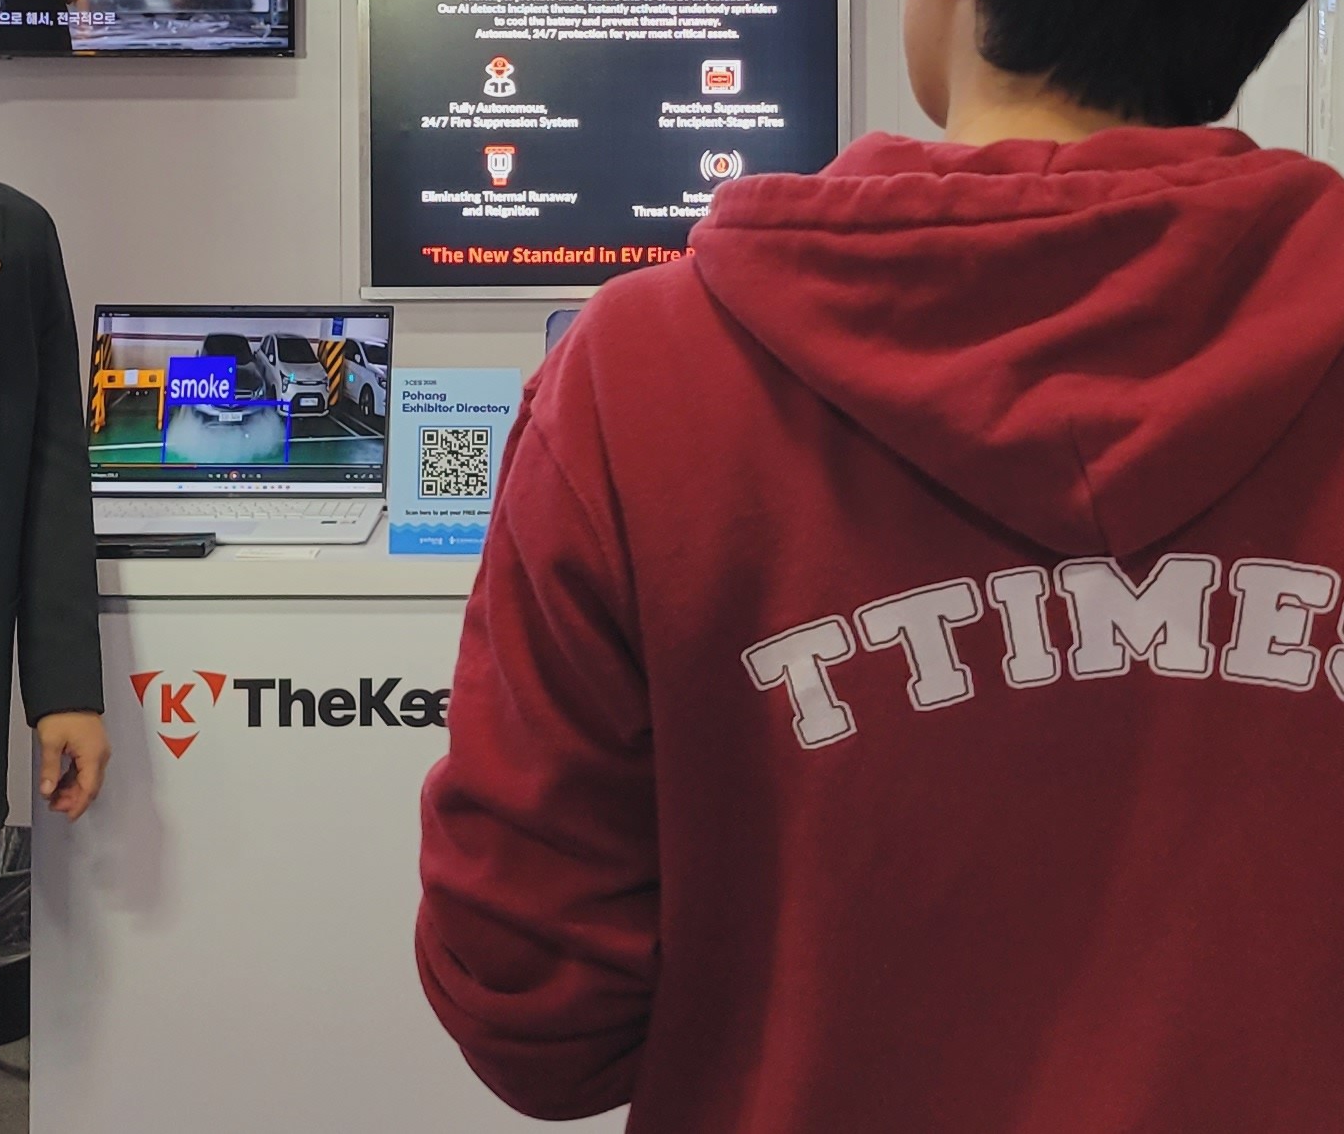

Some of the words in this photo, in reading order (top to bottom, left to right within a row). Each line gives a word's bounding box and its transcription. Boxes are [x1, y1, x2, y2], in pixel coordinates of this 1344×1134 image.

[437, 3, 458, 15] Our
[470, 3, 506, 15] detects
[507, 3, 549, 15] incipient
[588, 3, 629, 15] instantly
[630, 3, 677, 15] activating
[678, 3, 730, 15] underbody
[731, 3, 778, 15] sprinklers
[494, 16, 505, 28] to
[506, 16, 527, 28] cool
[528, 16, 545, 28] the
[546, 16, 581, 28] battery
[582, 16, 600, 28] and
[601, 16, 639, 28] prevent
[640, 16, 677, 28] thermal
[449, 102, 476, 116] Fully
[476, 102, 548, 115] Autonomous,
[661, 102, 712, 114] Proactive
[714, 102, 778, 116] Suppression
[421, 117, 449, 129] 24/7
[450, 117, 472, 128] Fire
[473, 117, 537, 130] Suppression
[539, 117, 579, 130] System
[658, 117, 675, 128] for
[758, 117, 784, 128] Fires
[421, 191, 481, 204] Eliminating
[482, 191, 526, 203] Thermal
[528, 191, 579, 204] Runaway
[462, 205, 483, 217] and
[484, 205, 540, 218] Reignition
[632, 206, 668, 217] Threat
[468, 248, 509, 263] New
[512, 247, 593, 263] Standard
[599, 247, 617, 263] in
[620, 248, 643, 263] EV
[647, 247, 681, 263] Fire
[169, 372, 231, 400] smoke
[402, 390, 447, 402] Pohang
[402, 402, 455, 413] Exhibitor
[456, 403, 511, 415] Directory
